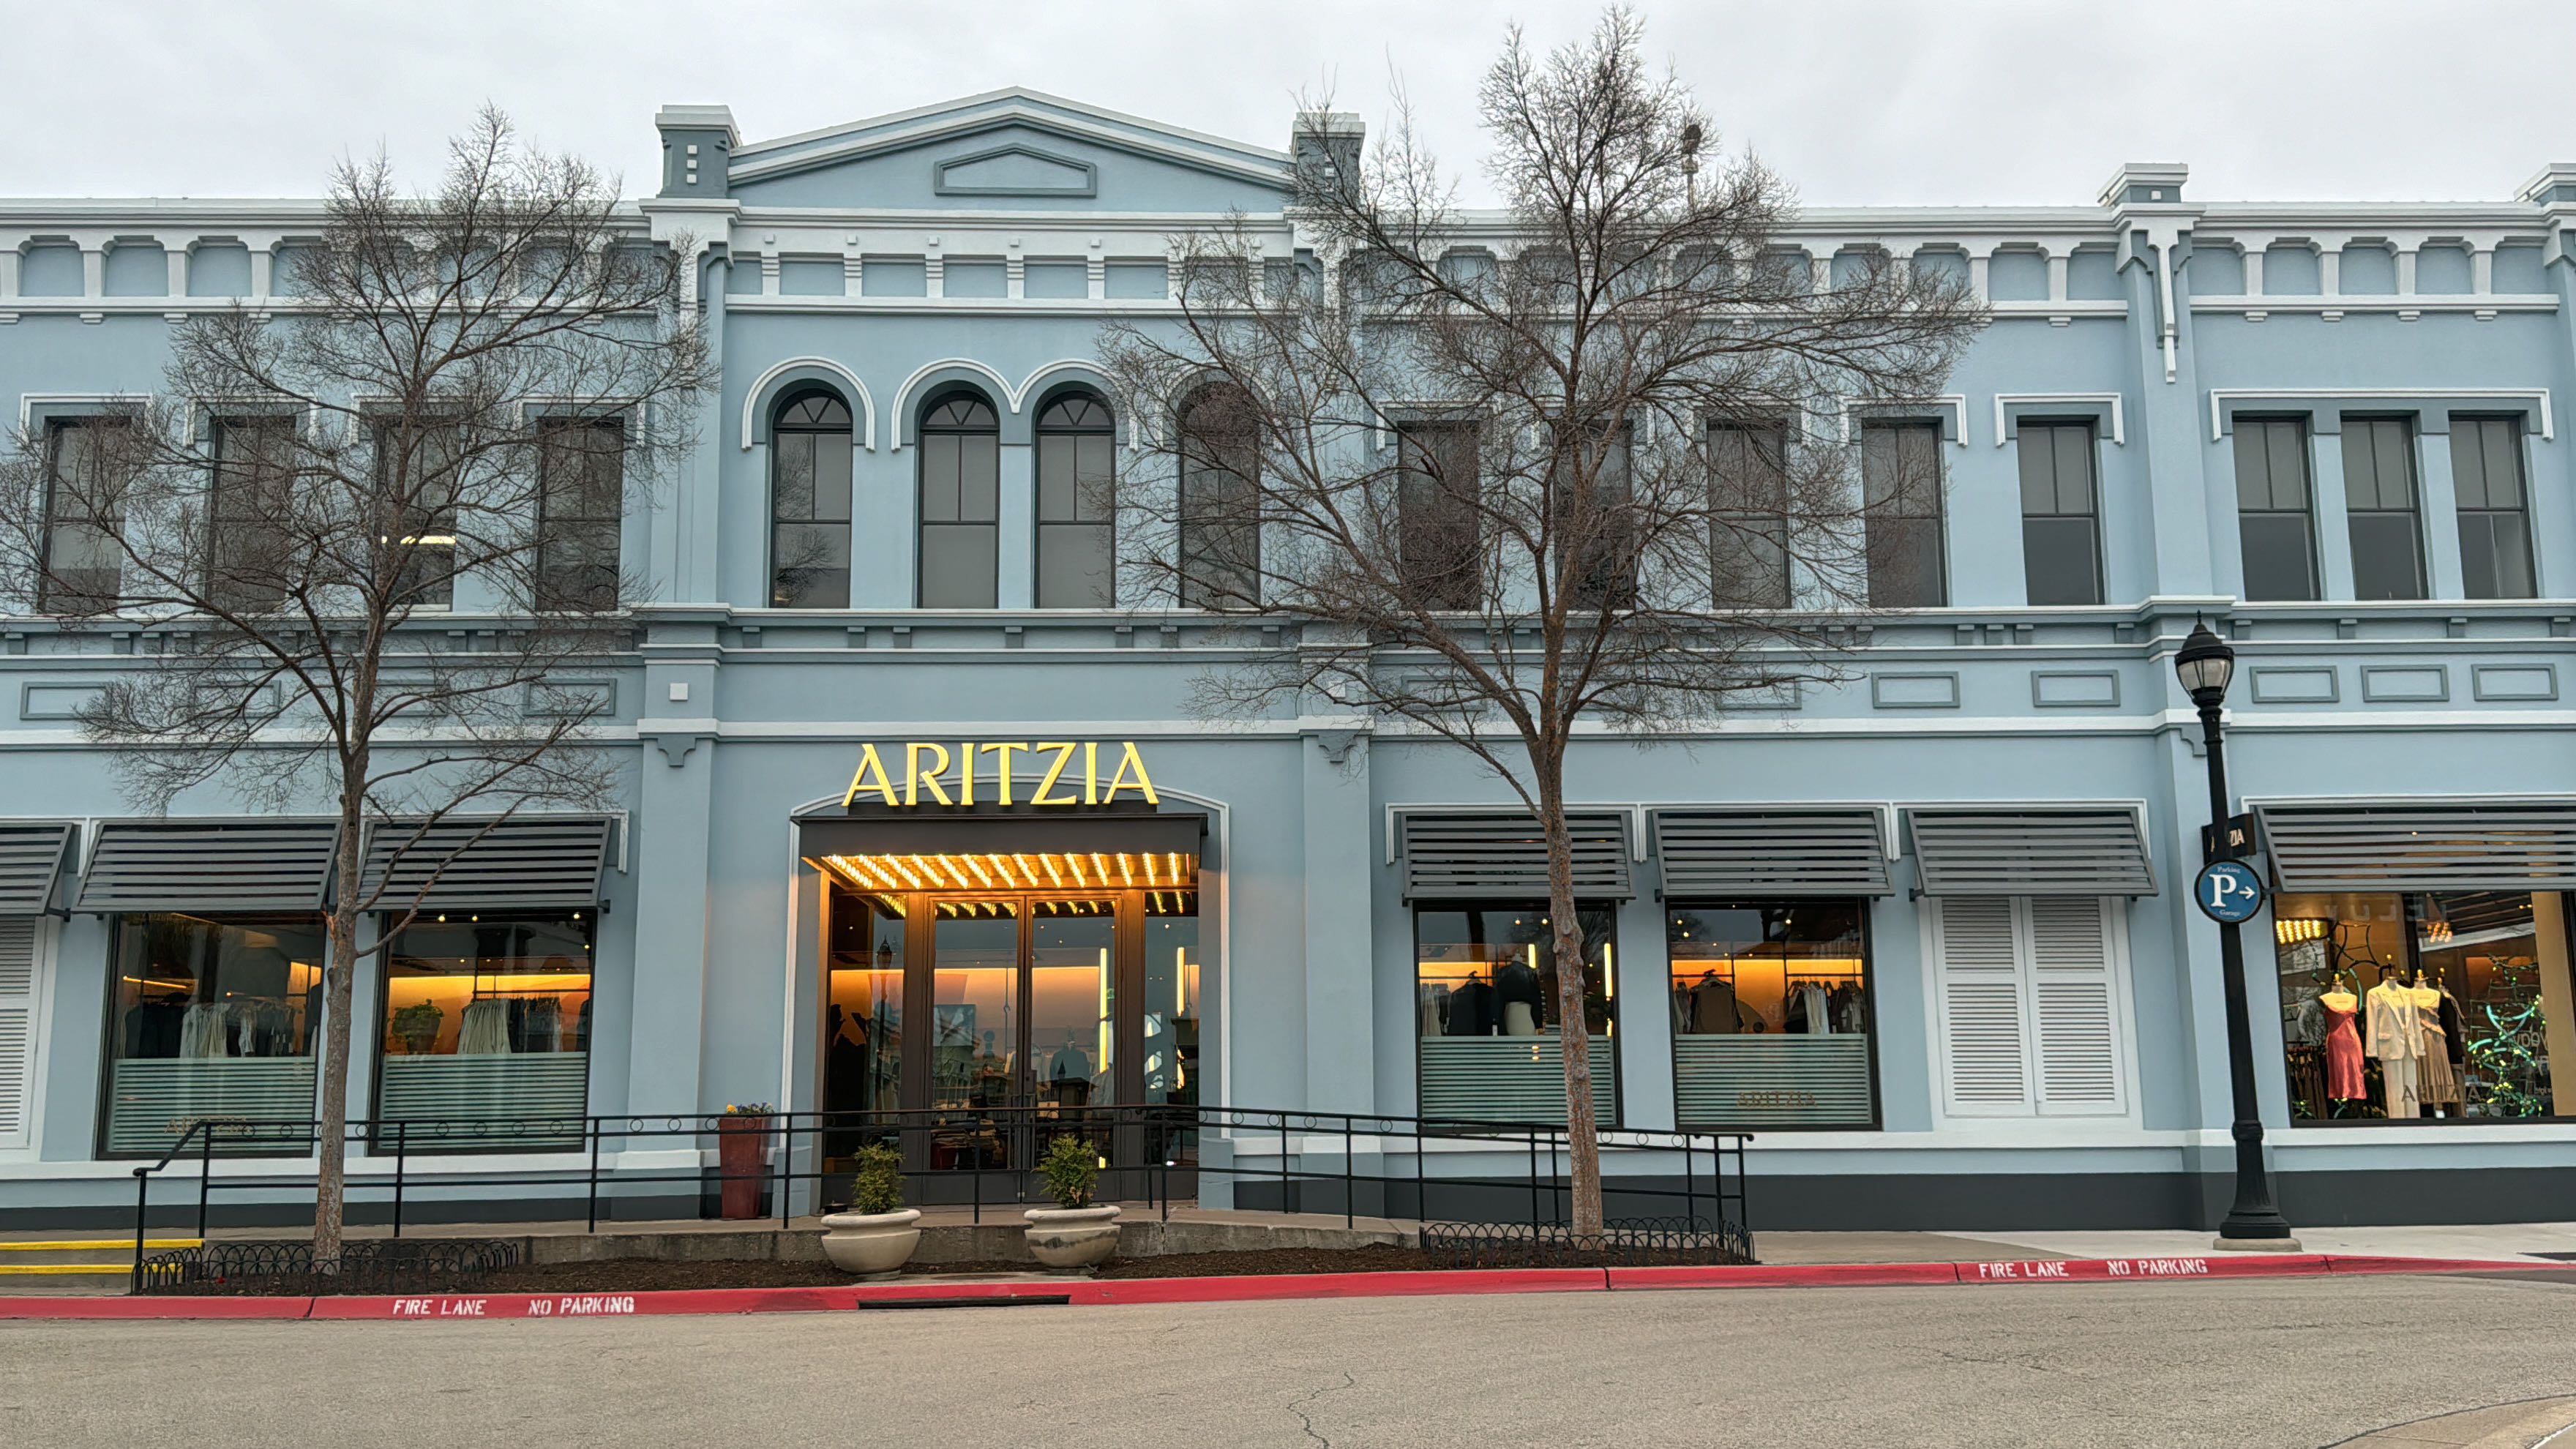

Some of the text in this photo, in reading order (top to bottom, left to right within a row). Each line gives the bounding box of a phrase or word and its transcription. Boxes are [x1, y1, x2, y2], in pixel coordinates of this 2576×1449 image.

[841, 741, 1159, 806] ARITZIA
[2217, 866, 2242, 874] Parking
[2208, 874, 2237, 907] P
[2219, 909, 2241, 917] Garage
[1737, 1090, 1816, 1107] ARITZIA
[1978, 1258, 2209, 1278] FIRE LANE NO PARKING
[392, 1296, 635, 1316] FIRE LANE NO PARKING
